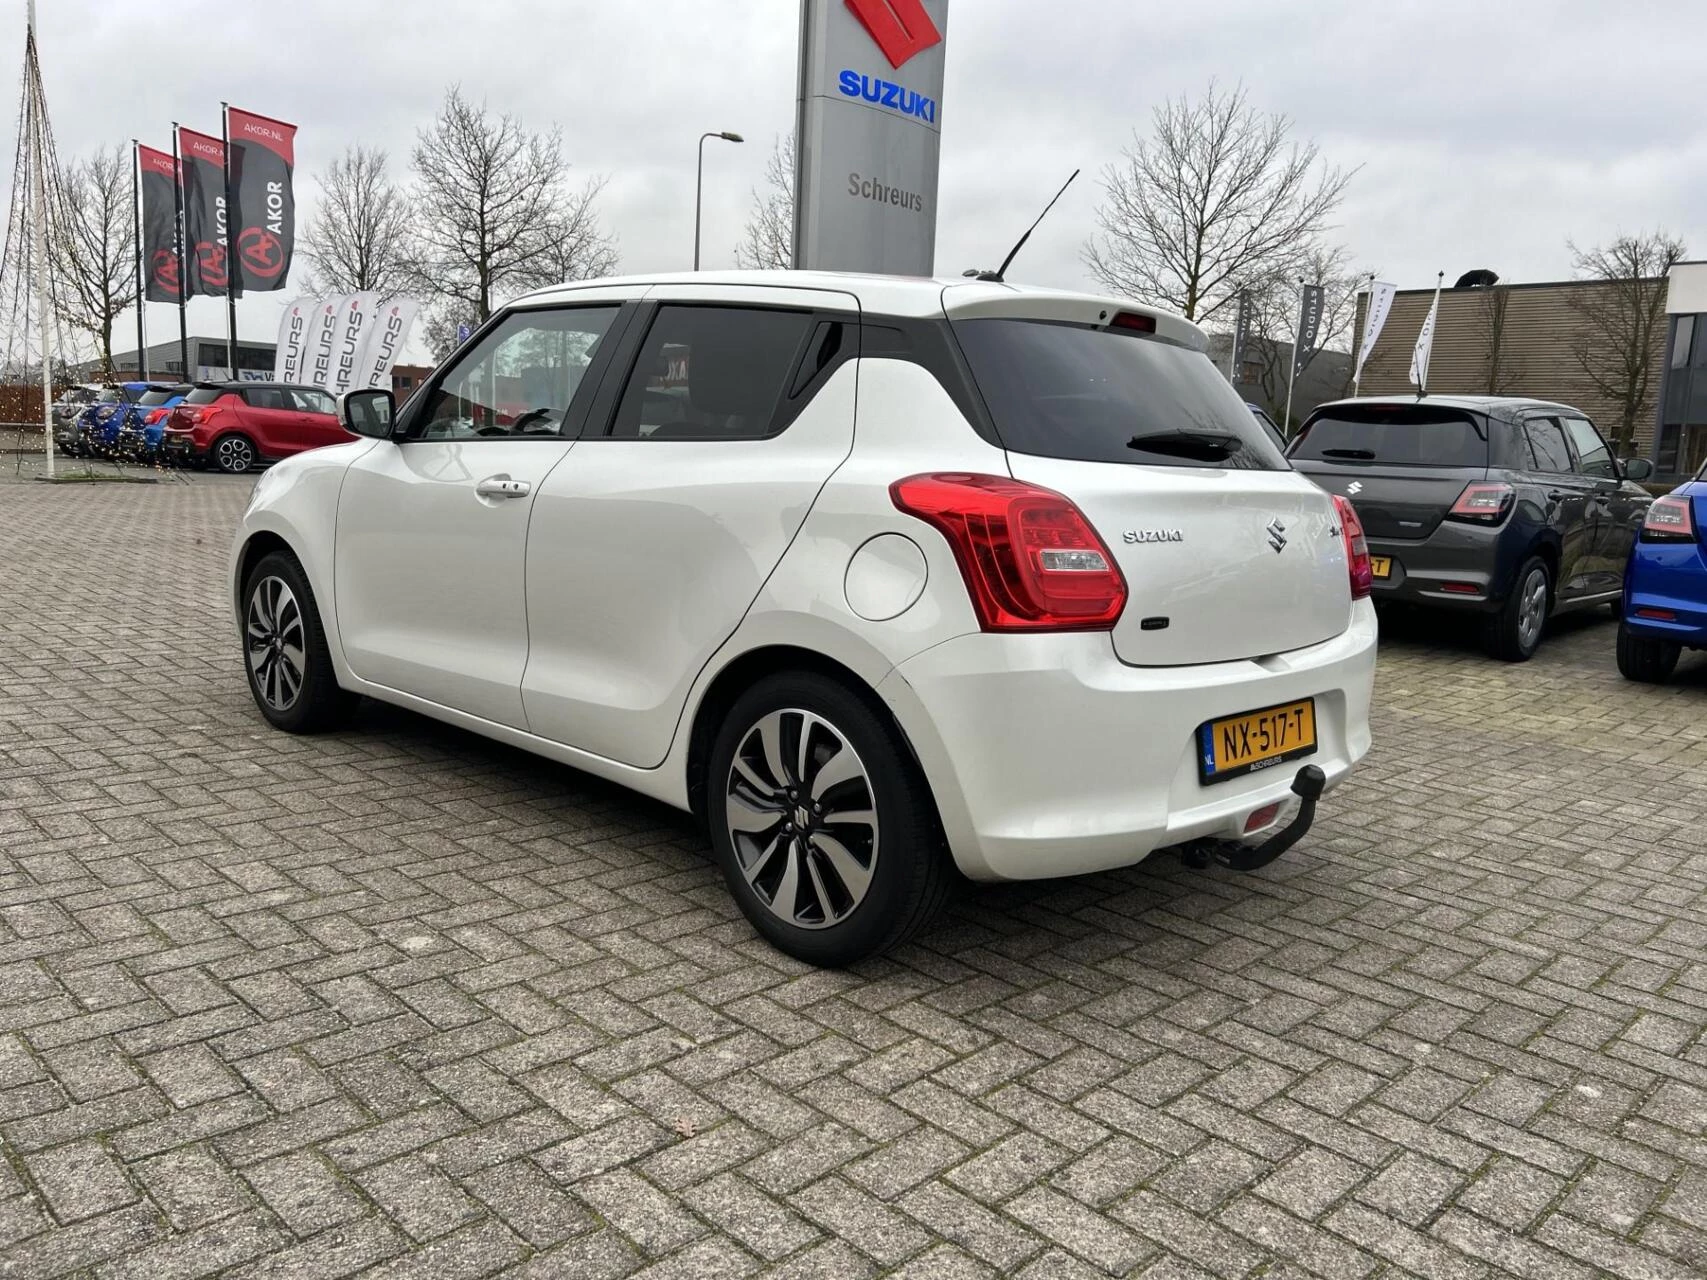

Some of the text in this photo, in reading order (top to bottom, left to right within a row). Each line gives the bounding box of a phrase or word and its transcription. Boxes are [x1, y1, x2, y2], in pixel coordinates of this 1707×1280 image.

[839, 70, 935, 123] SUZUKI
[244, 122, 284, 142] AKOR.NL
[266, 181, 283, 235] AKOR
[848, 172, 922, 212] Schreurs
[1302, 289, 1317, 353] STUDIO X
[1123, 529, 1183, 544] SUZUKI
[1223, 708, 1304, 762] NX-517-T
[1204, 754, 1215, 766] NL
